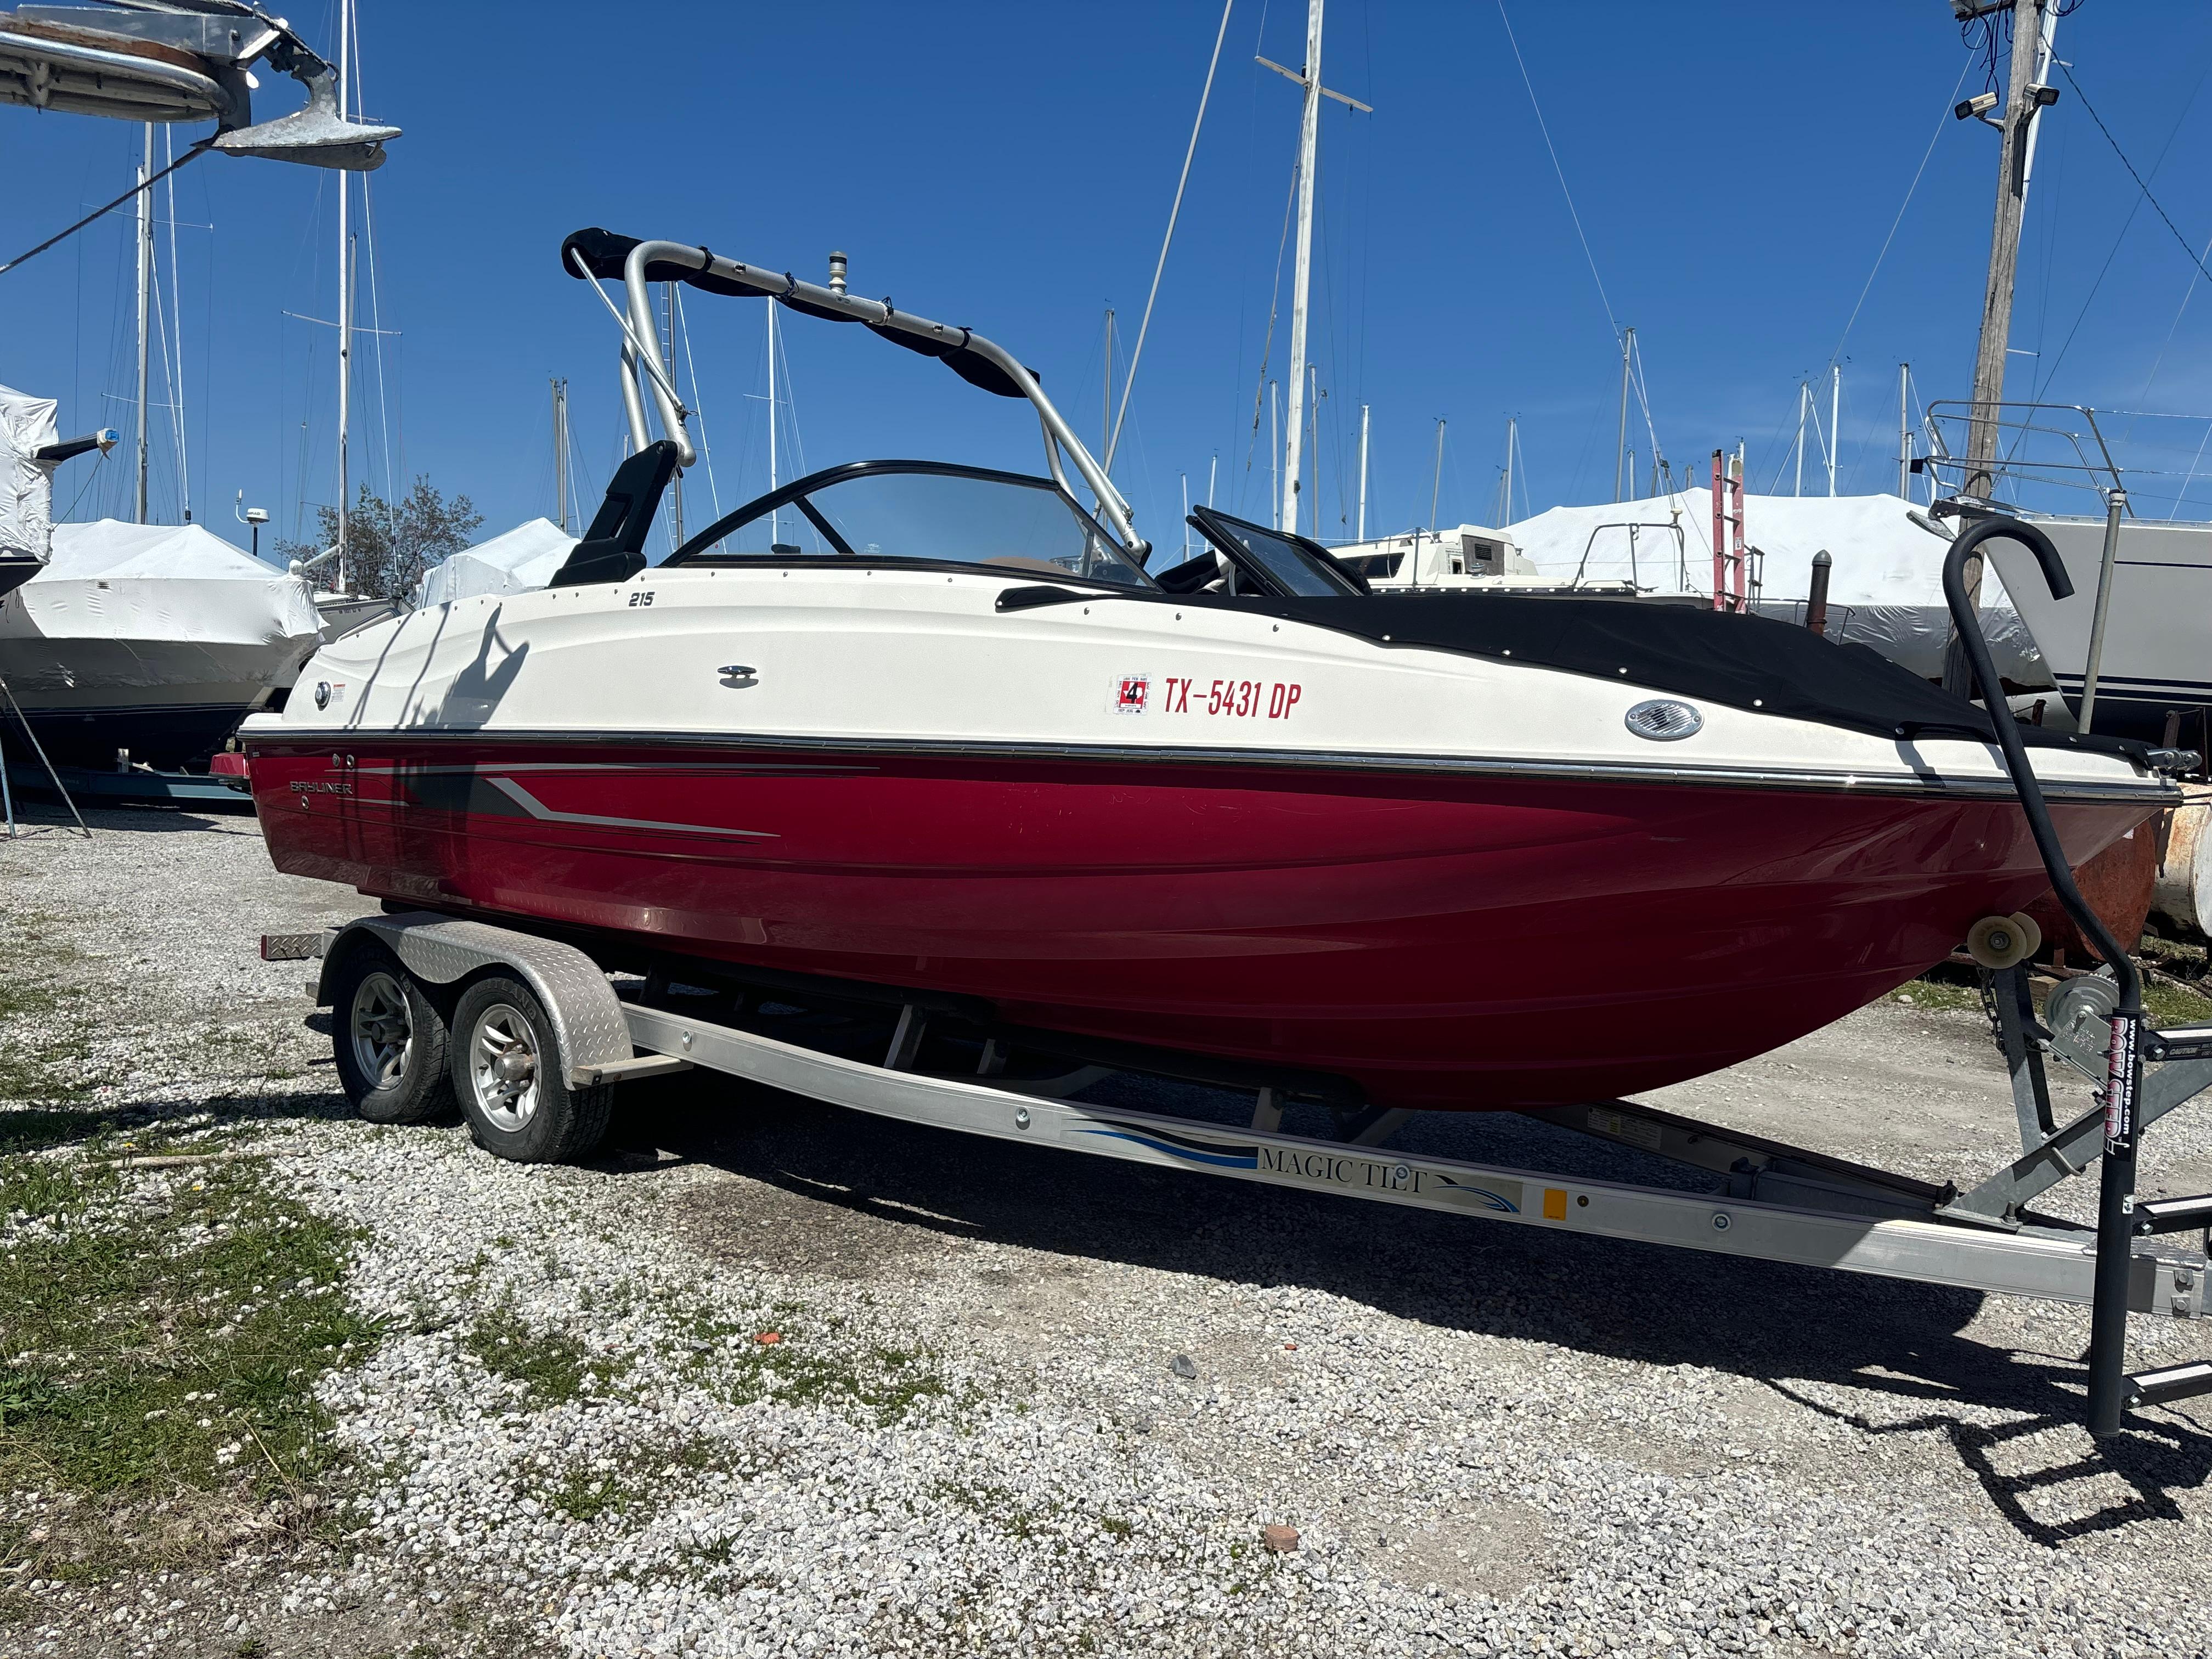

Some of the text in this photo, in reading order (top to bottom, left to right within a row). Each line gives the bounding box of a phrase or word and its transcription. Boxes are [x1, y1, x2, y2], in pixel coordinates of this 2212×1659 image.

[629, 591, 655, 606] 215
[1126, 682, 1138, 704] 4
[1165, 678, 1301, 719] TX-5431 DP
[290, 781, 353, 794] BAYLINER
[2108, 1017, 2128, 1078] BOW
[2123, 1019, 2136, 1135] www.bowstep.com
[2104, 1078, 2124, 1138] STEP
[1262, 1148, 1353, 1183] MAGIC
